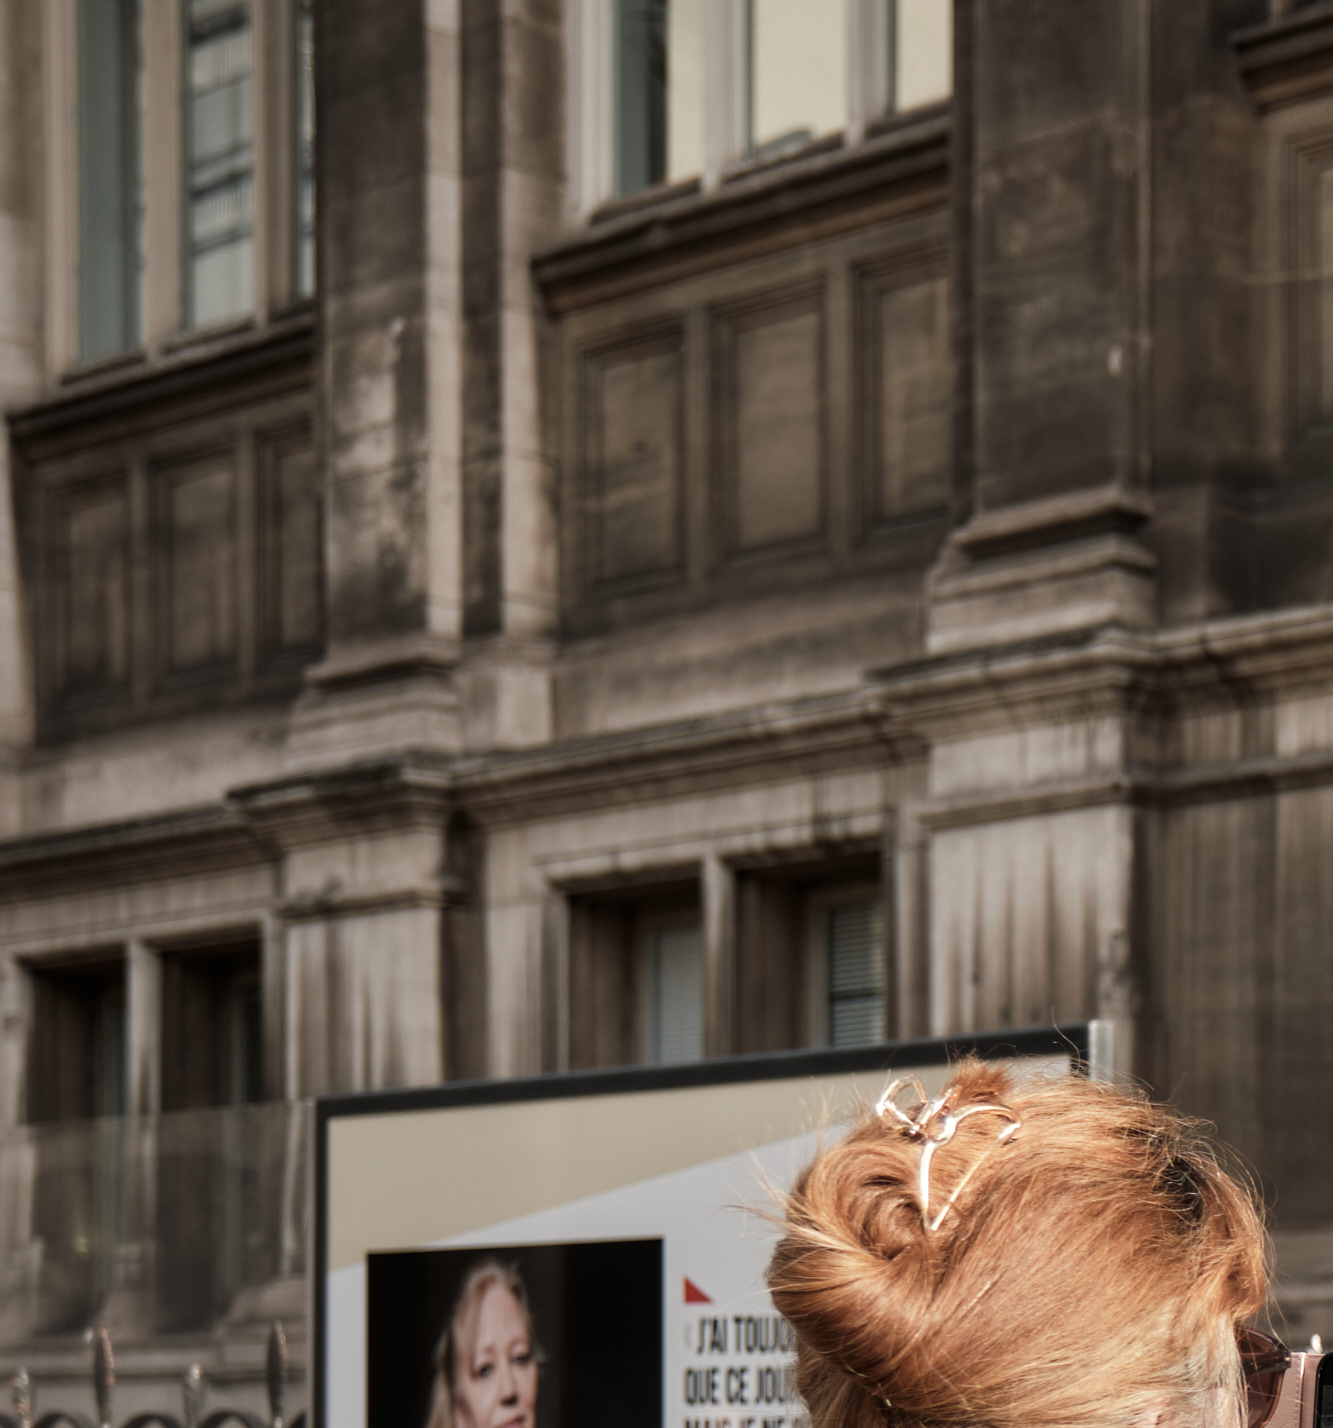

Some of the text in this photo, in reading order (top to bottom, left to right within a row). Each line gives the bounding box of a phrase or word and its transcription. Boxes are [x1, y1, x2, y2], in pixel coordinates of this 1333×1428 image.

[684, 1366, 796, 1405] QUE CE JOU
